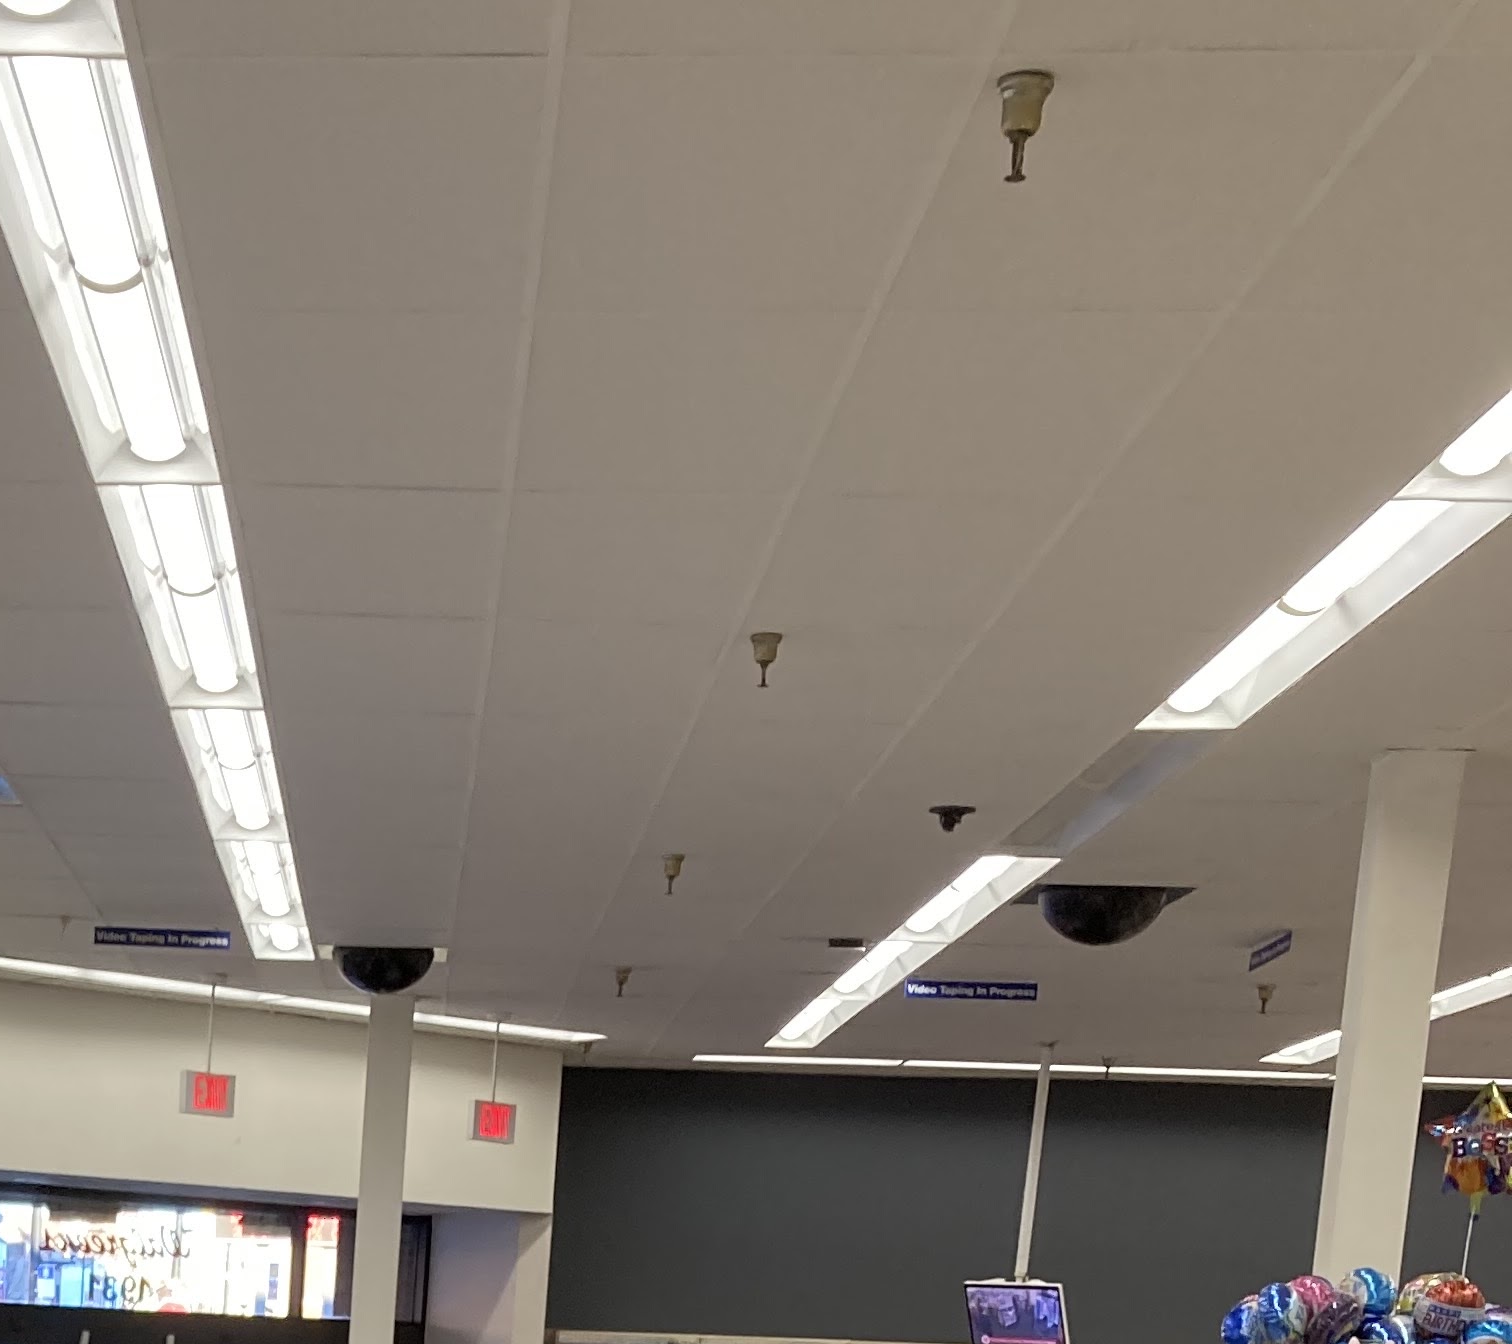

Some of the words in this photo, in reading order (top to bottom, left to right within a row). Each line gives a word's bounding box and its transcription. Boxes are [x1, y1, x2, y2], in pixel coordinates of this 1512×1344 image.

[96, 929, 127, 942] Video
[130, 932, 165, 944] Taping
[168, 934, 179, 944] In
[181, 935, 228, 947] Progress
[907, 983, 937, 995] Video
[940, 985, 975, 997] Taping
[976, 986, 987, 996] In
[989, 986, 1035, 999] Progress
